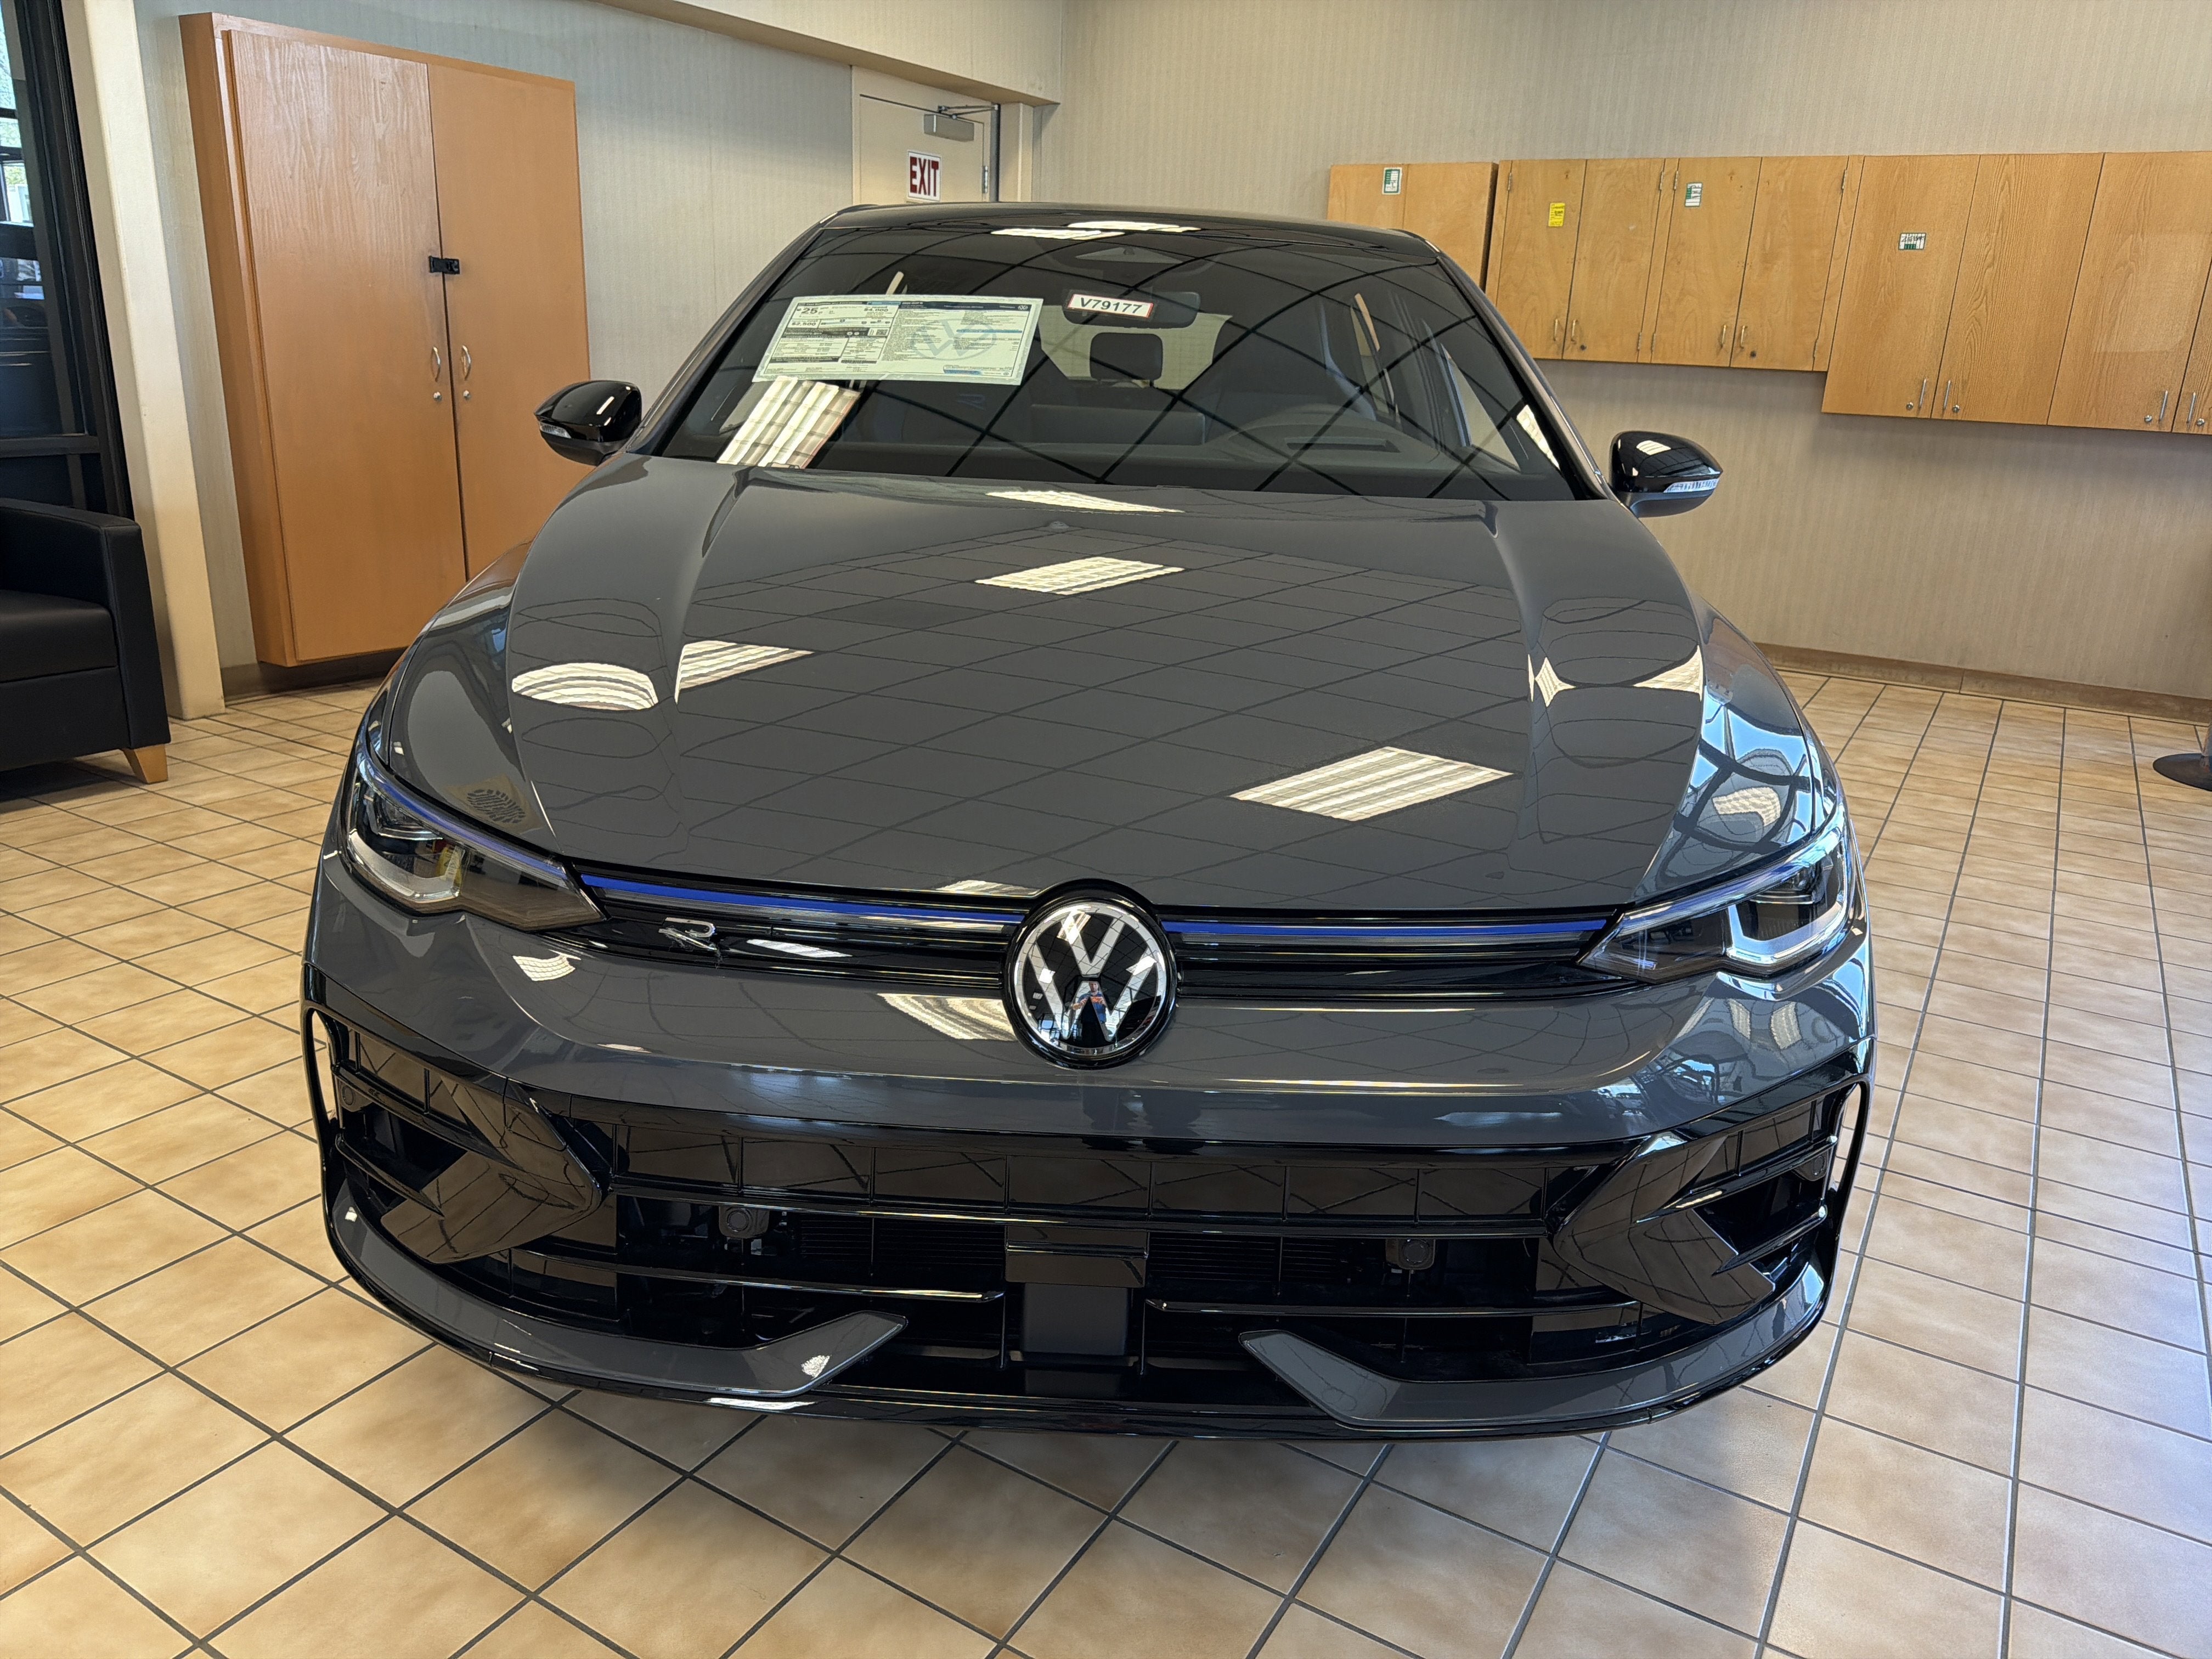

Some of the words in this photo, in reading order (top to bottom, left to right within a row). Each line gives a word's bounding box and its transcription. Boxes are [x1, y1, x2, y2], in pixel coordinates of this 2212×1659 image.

[910, 156, 939, 197] EXIT
[1080, 297, 1142, 314] V79177
[658, 917, 717, 951] R
[1023, 906, 1160, 1045] VW
